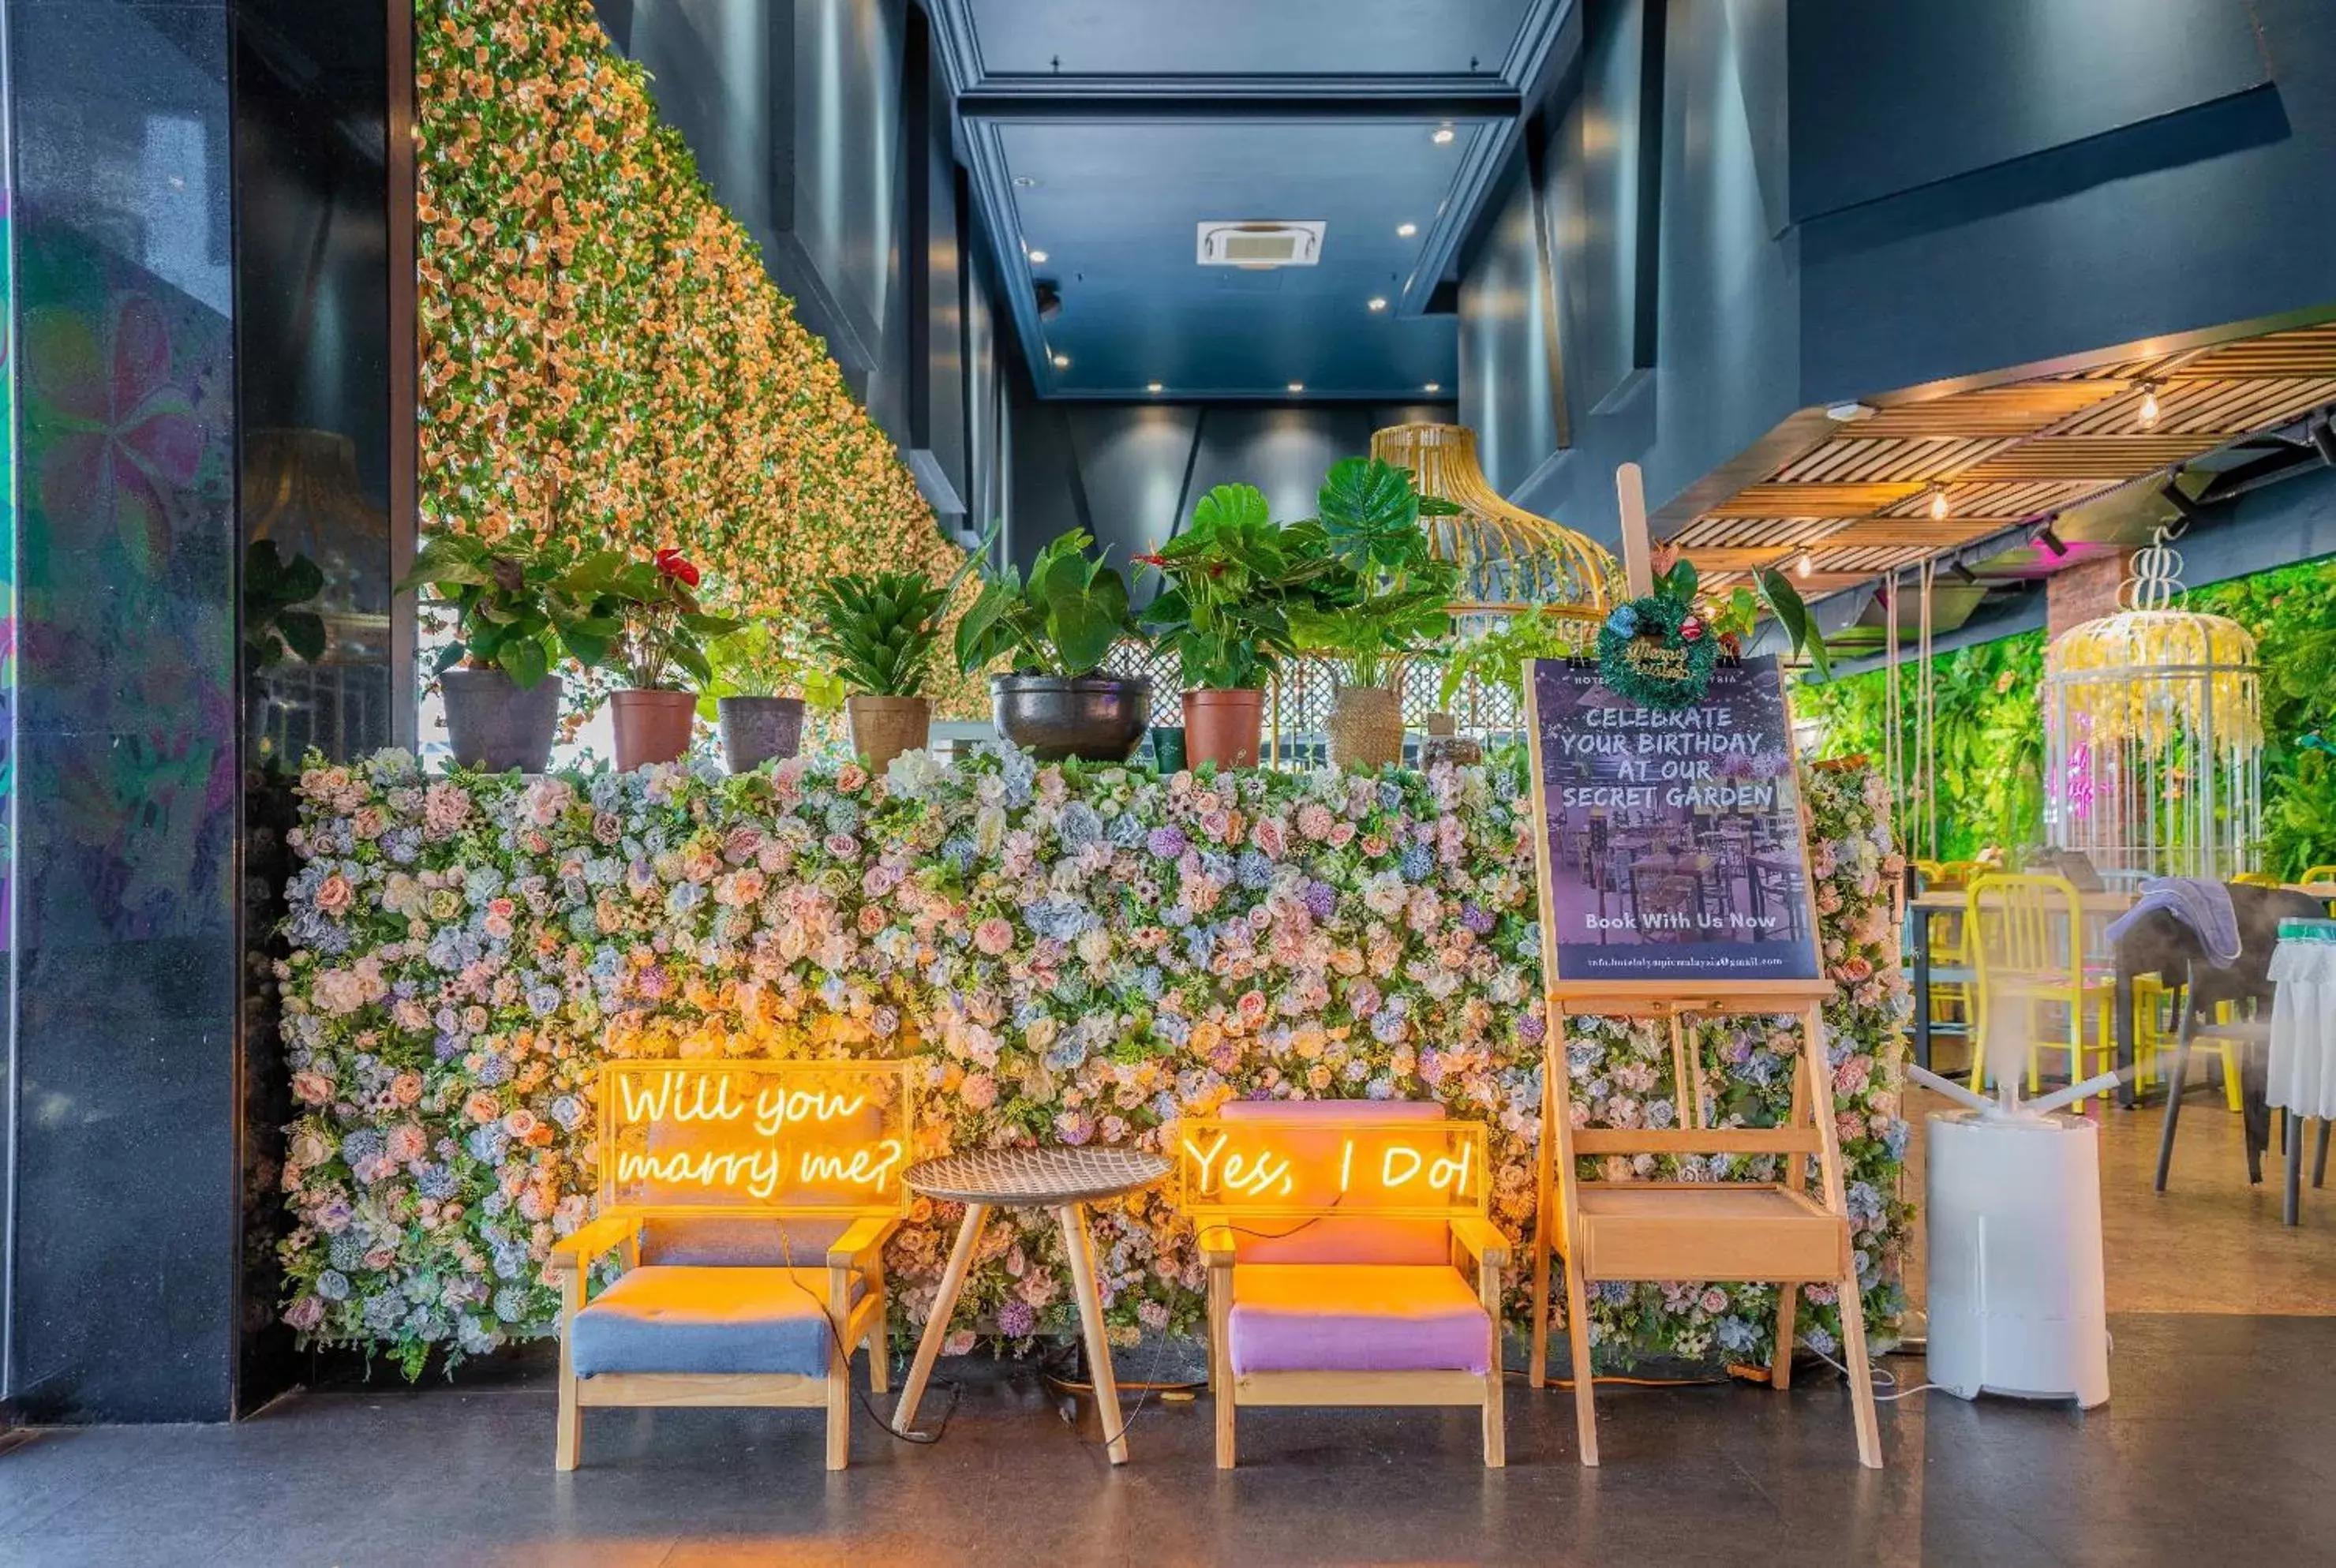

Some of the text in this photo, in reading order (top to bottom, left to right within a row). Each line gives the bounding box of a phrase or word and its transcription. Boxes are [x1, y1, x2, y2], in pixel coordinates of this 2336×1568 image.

[1574, 676, 1605, 685] HOTE
[1585, 707, 1733, 729] CELEBRATE
[1561, 732, 1763, 755] YOUR BIRTHDAY
[1618, 759, 1713, 782] AT OUR
[1563, 786, 1773, 809] SECRET GARDEN
[1585, 911, 1776, 930] Book With Us Now
[620, 1070, 865, 1136] Will you
[617, 1139, 902, 1199] marry me?
[1184, 1132, 1294, 1197] Yes,
